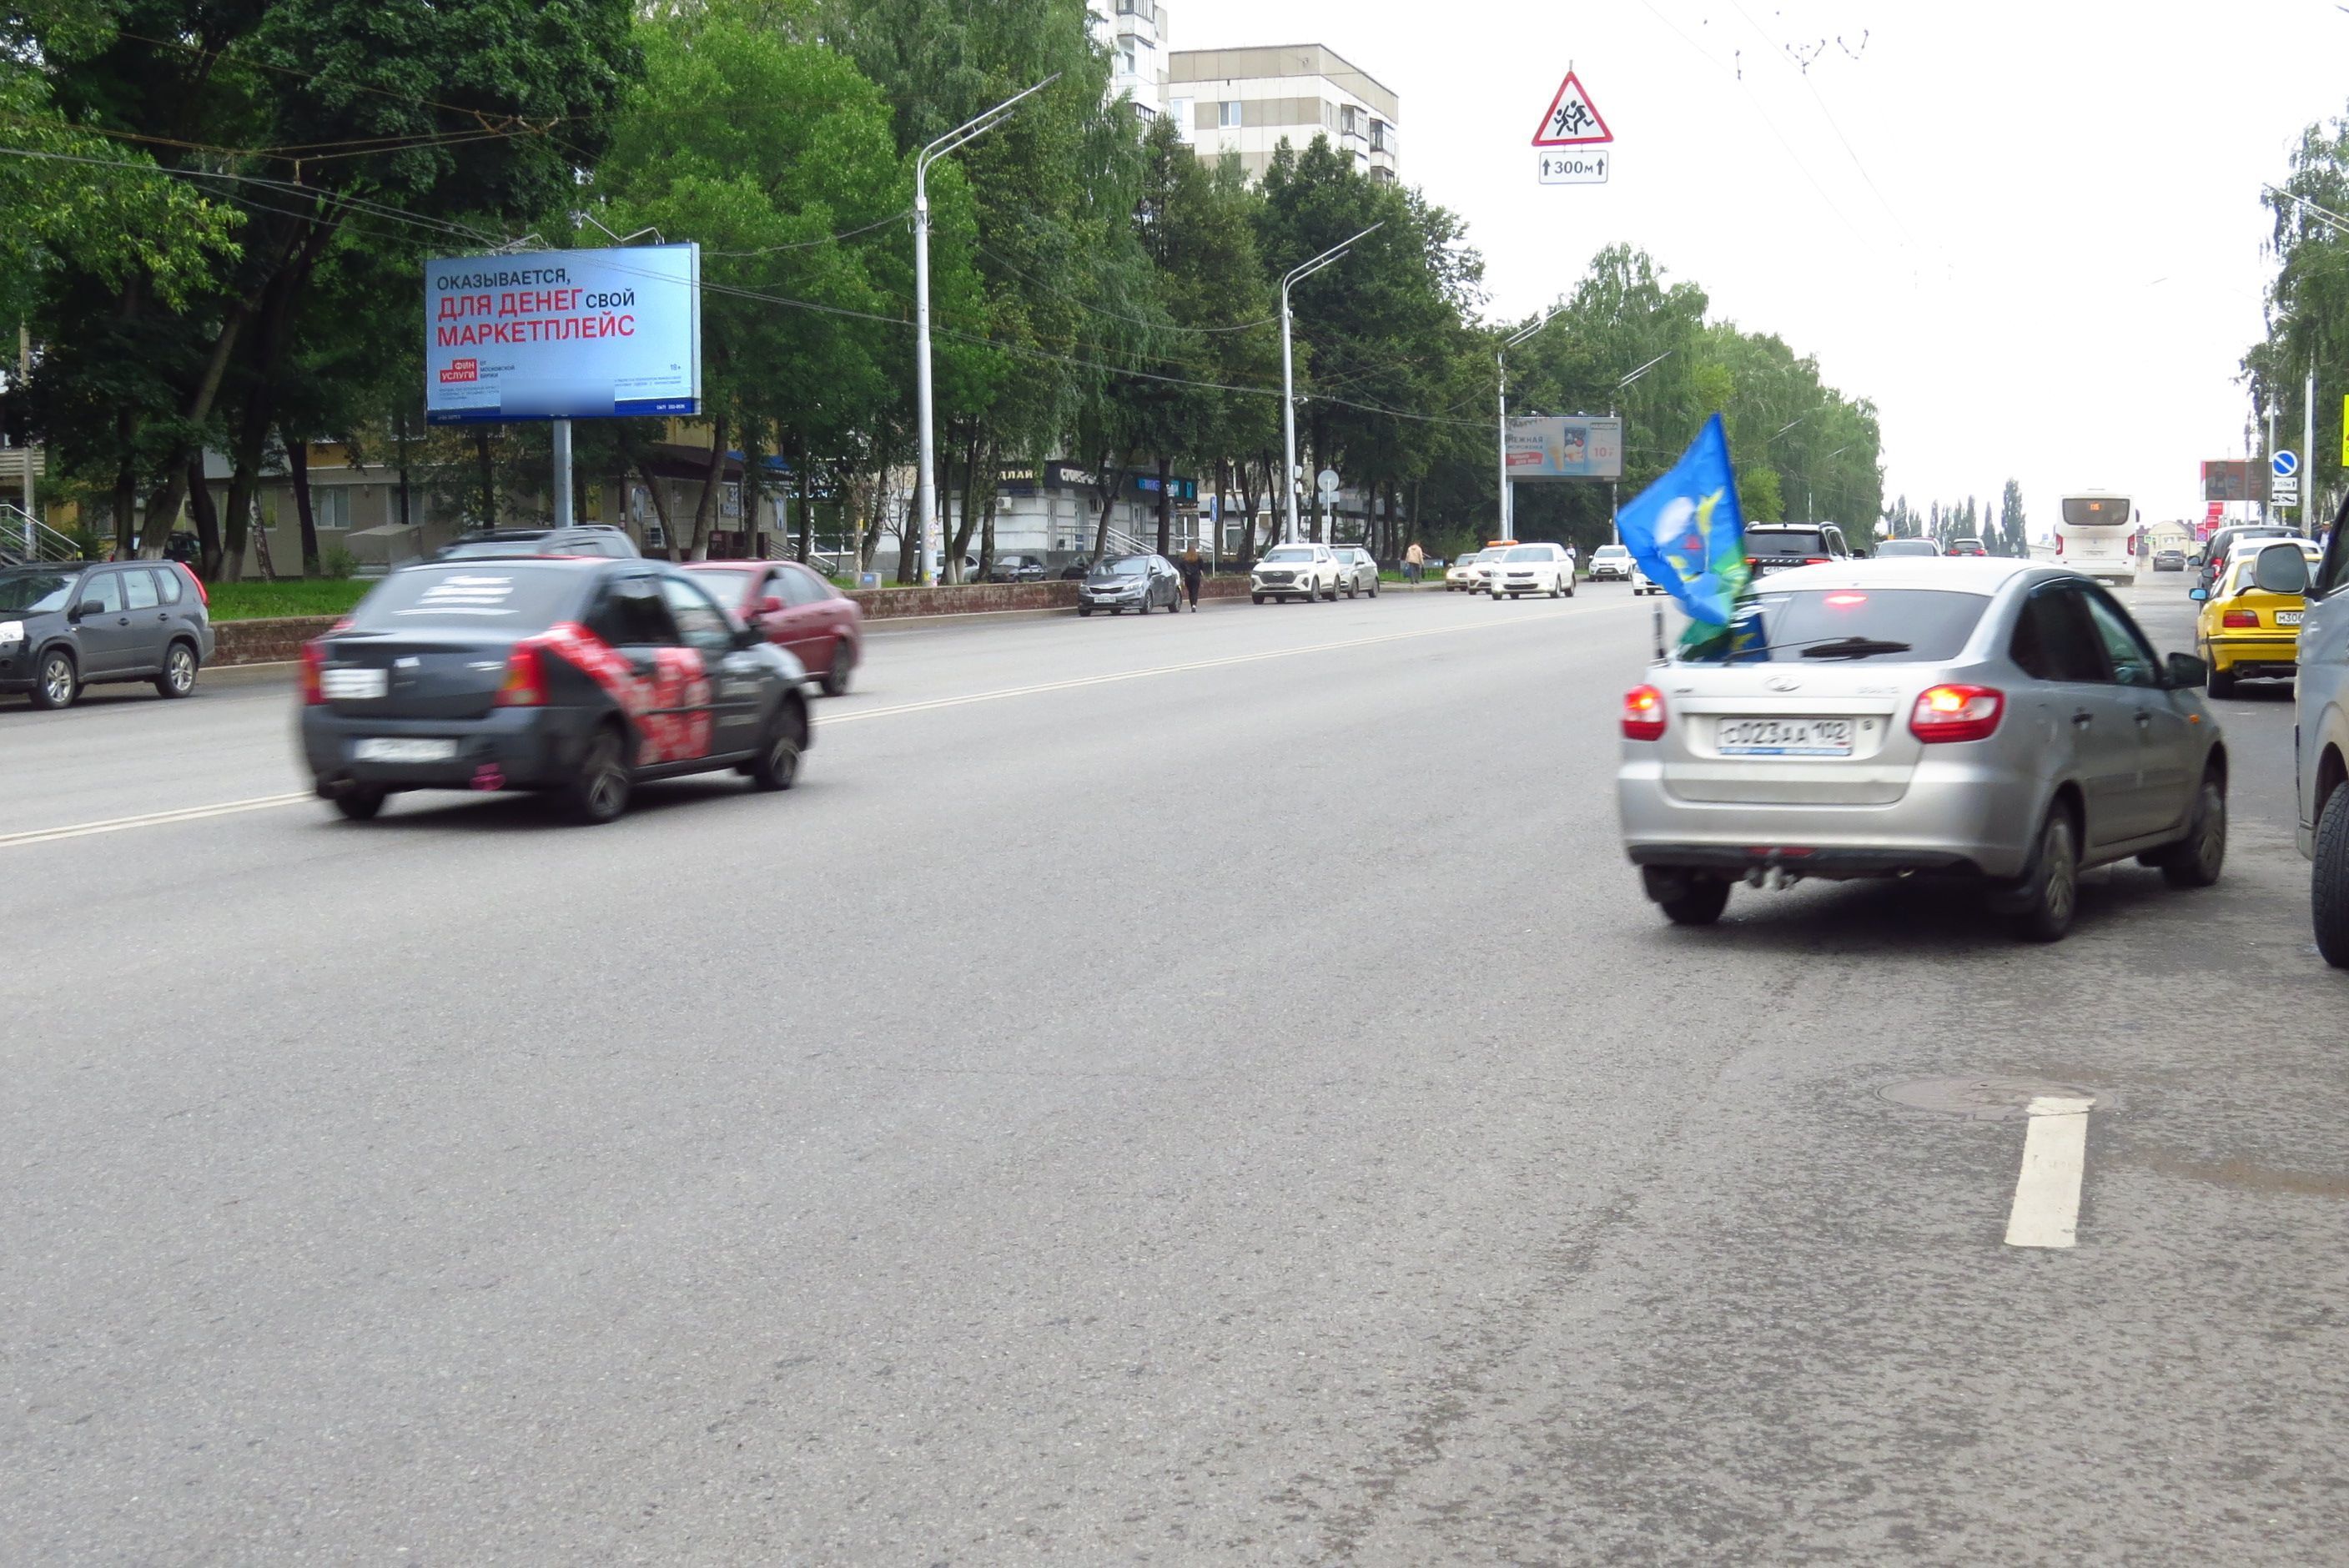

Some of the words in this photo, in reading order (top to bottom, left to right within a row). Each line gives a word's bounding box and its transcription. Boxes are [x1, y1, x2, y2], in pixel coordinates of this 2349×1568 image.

[1554, 161, 1593, 174] 300м
[437, 269, 571, 290] ОКАЗЫВАЕТСЯ,
[438, 294, 491, 322] ДЛЯ
[498, 289, 583, 318] ДЕНЕГ
[586, 289, 635, 309] СВОЙ
[437, 311, 635, 347] МАРКЕТПЛЕЙС
[455, 361, 475, 369] ФИН
[441, 371, 475, 380] УСЛУГИ
